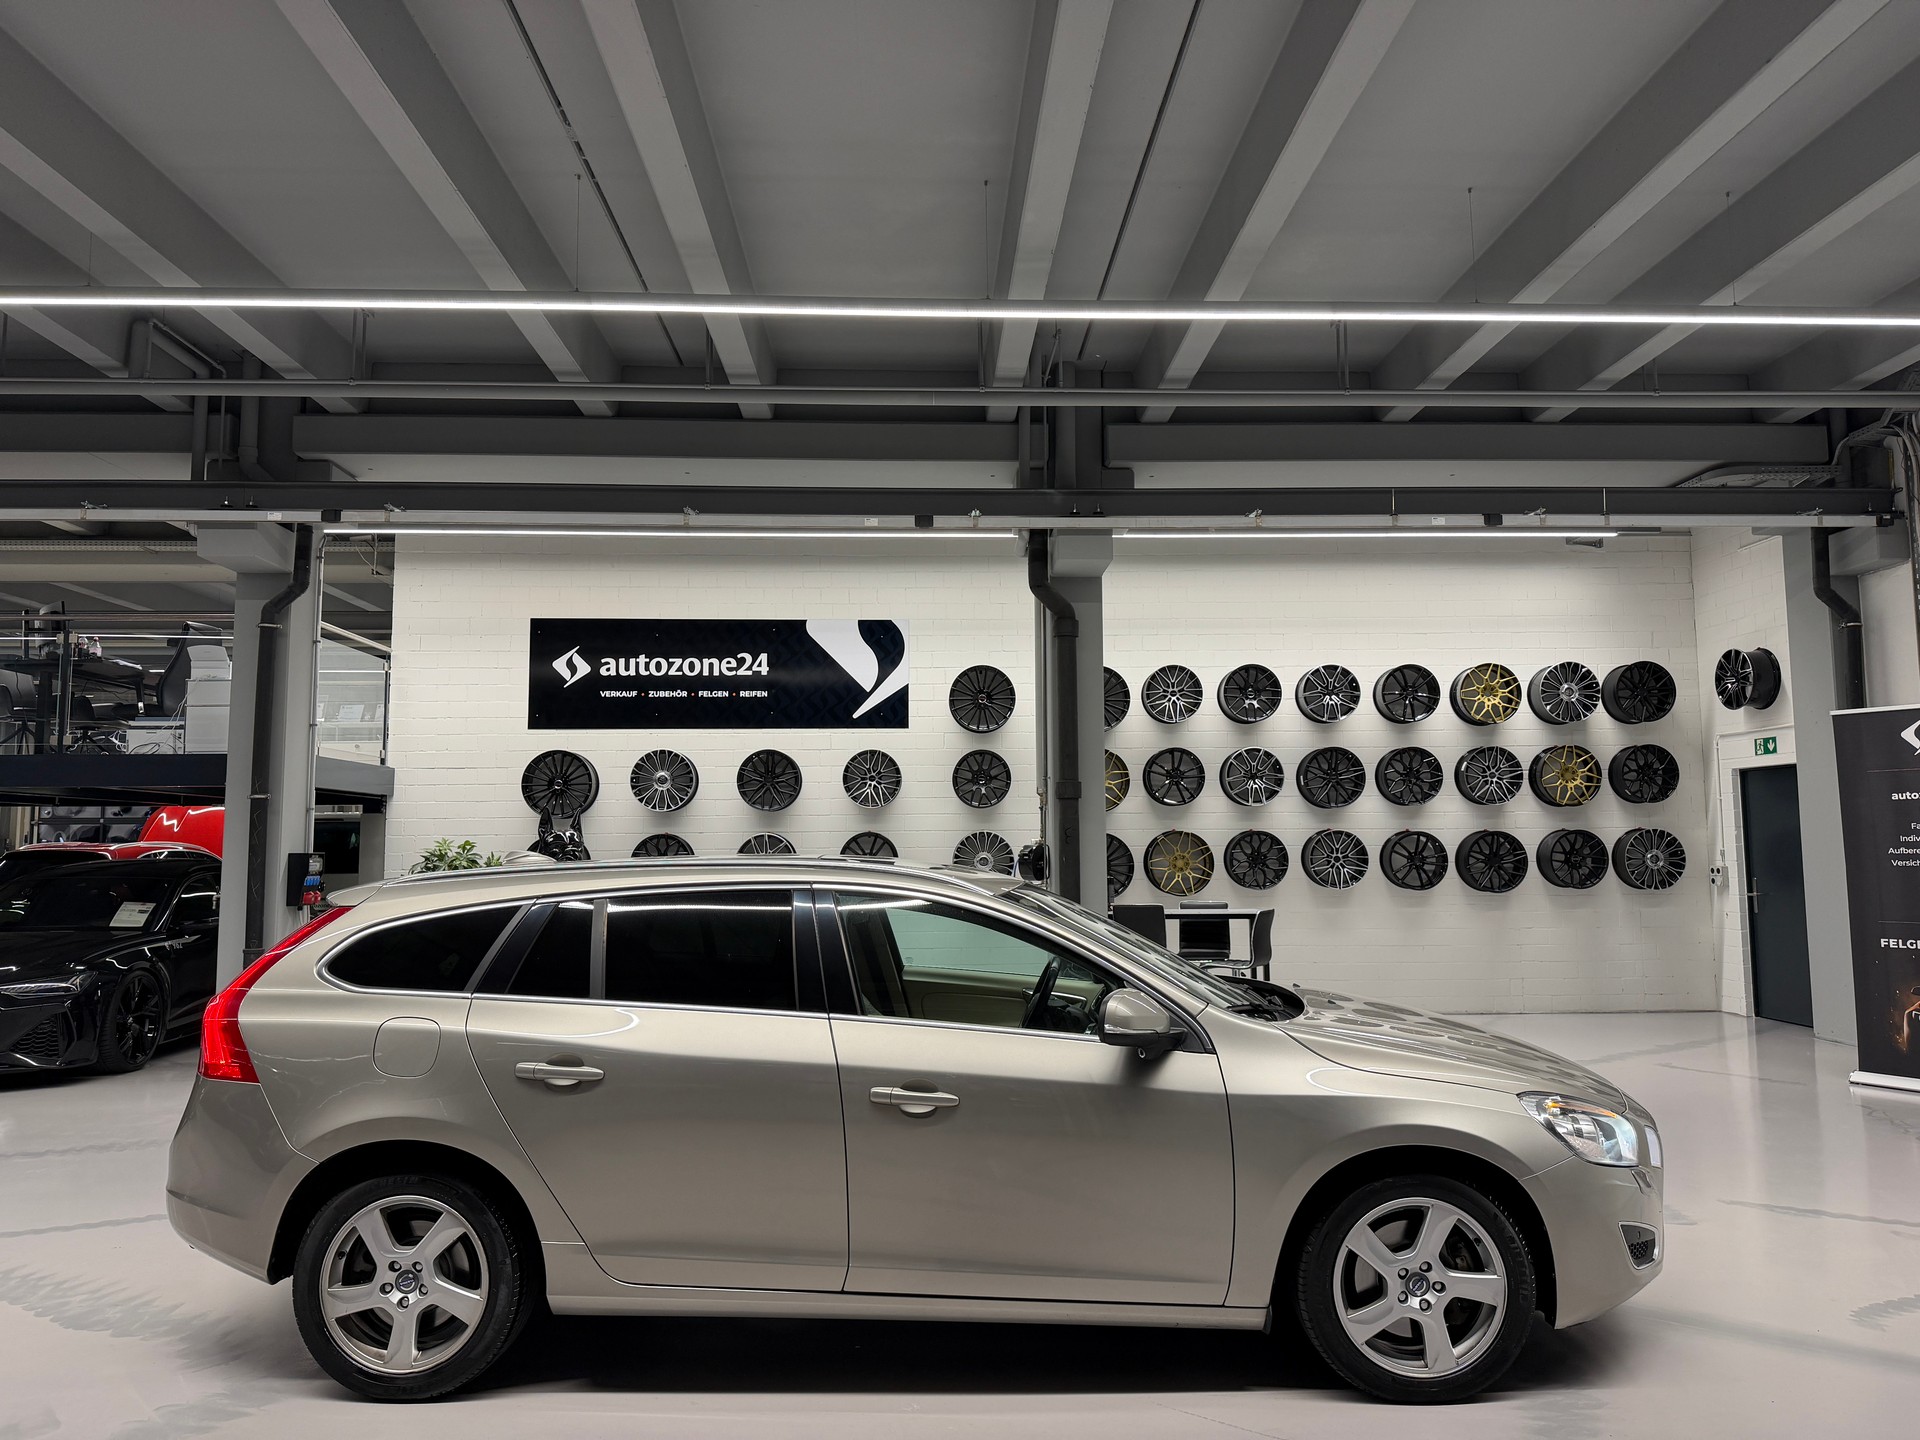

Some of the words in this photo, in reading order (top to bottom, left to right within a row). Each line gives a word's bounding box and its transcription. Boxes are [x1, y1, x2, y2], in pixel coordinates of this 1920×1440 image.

[599, 652, 769, 677] autozone24
[600, 690, 638, 698] VERKAUF
[648, 689, 688, 698] ZUBEHÖR
[698, 690, 729, 698] FELGEN
[739, 690, 768, 698] REIFEN
[1891, 791, 1920, 800] auto
